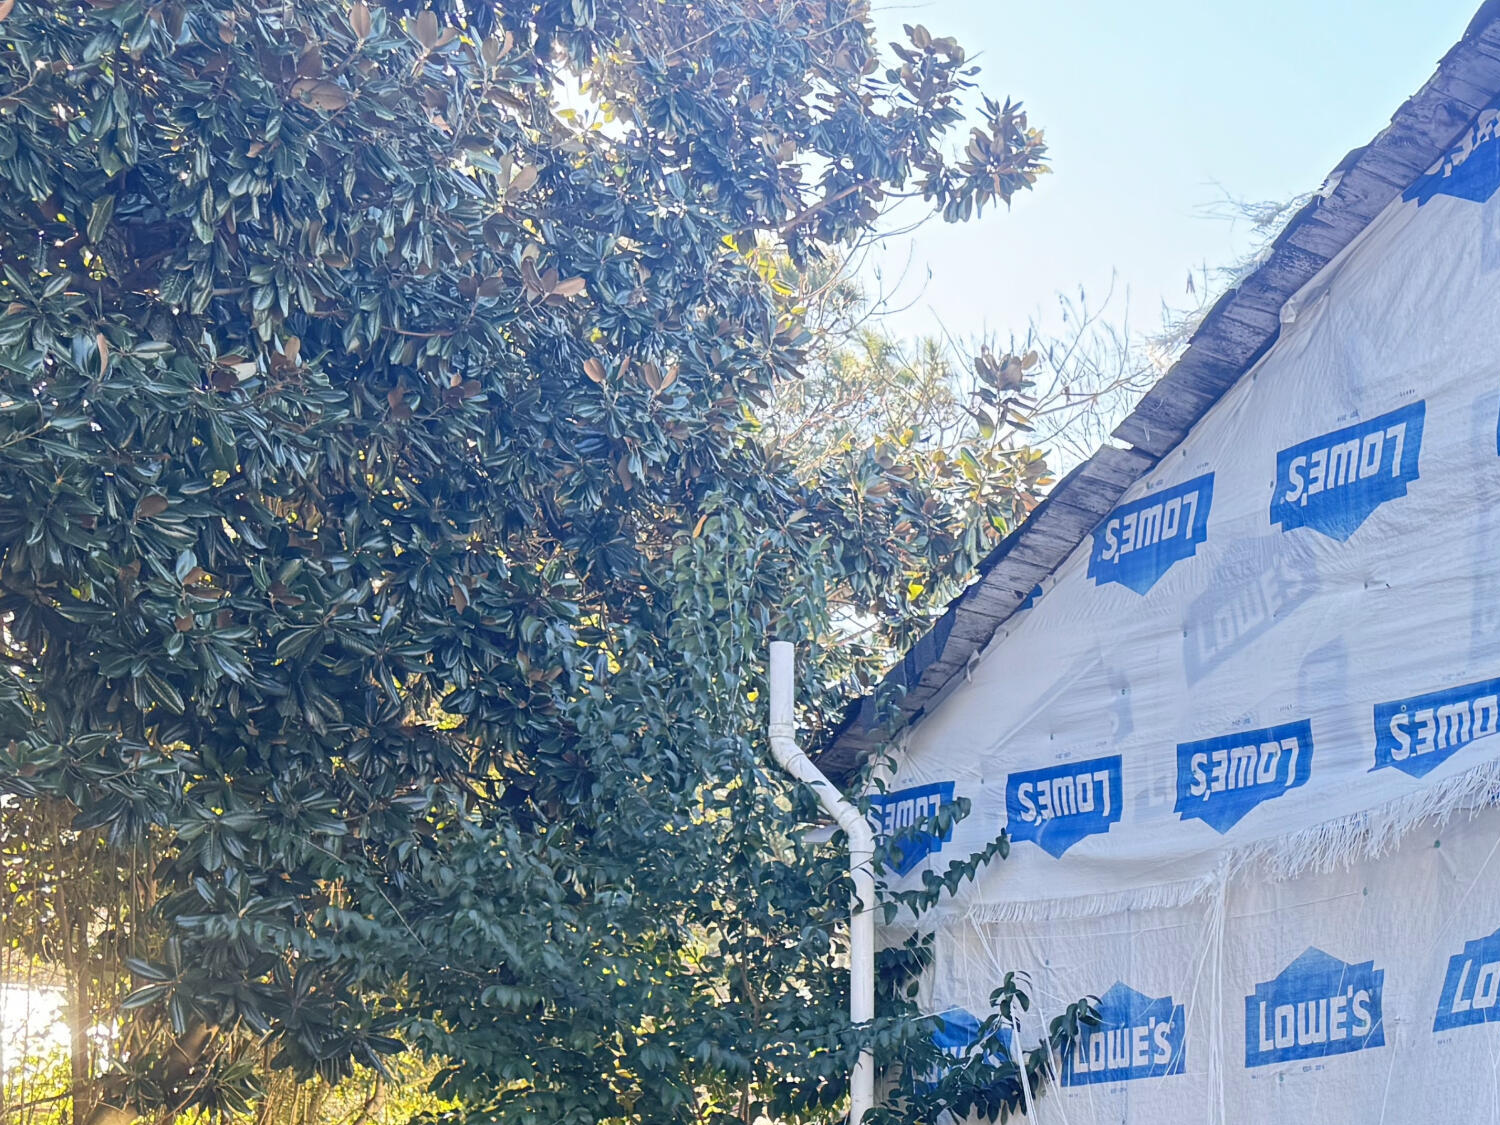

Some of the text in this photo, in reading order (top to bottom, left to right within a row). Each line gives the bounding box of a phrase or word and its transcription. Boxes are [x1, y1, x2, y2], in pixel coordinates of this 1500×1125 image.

[1284, 423, 1408, 506] LOWE'S
[1101, 489, 1200, 563] LOWE'S
[1016, 769, 1112, 828] LOWE'S
[1188, 734, 1299, 801] LOWE'S
[1073, 1016, 1172, 1074] LOWE'S
[1258, 982, 1371, 1054] LOWE'S
